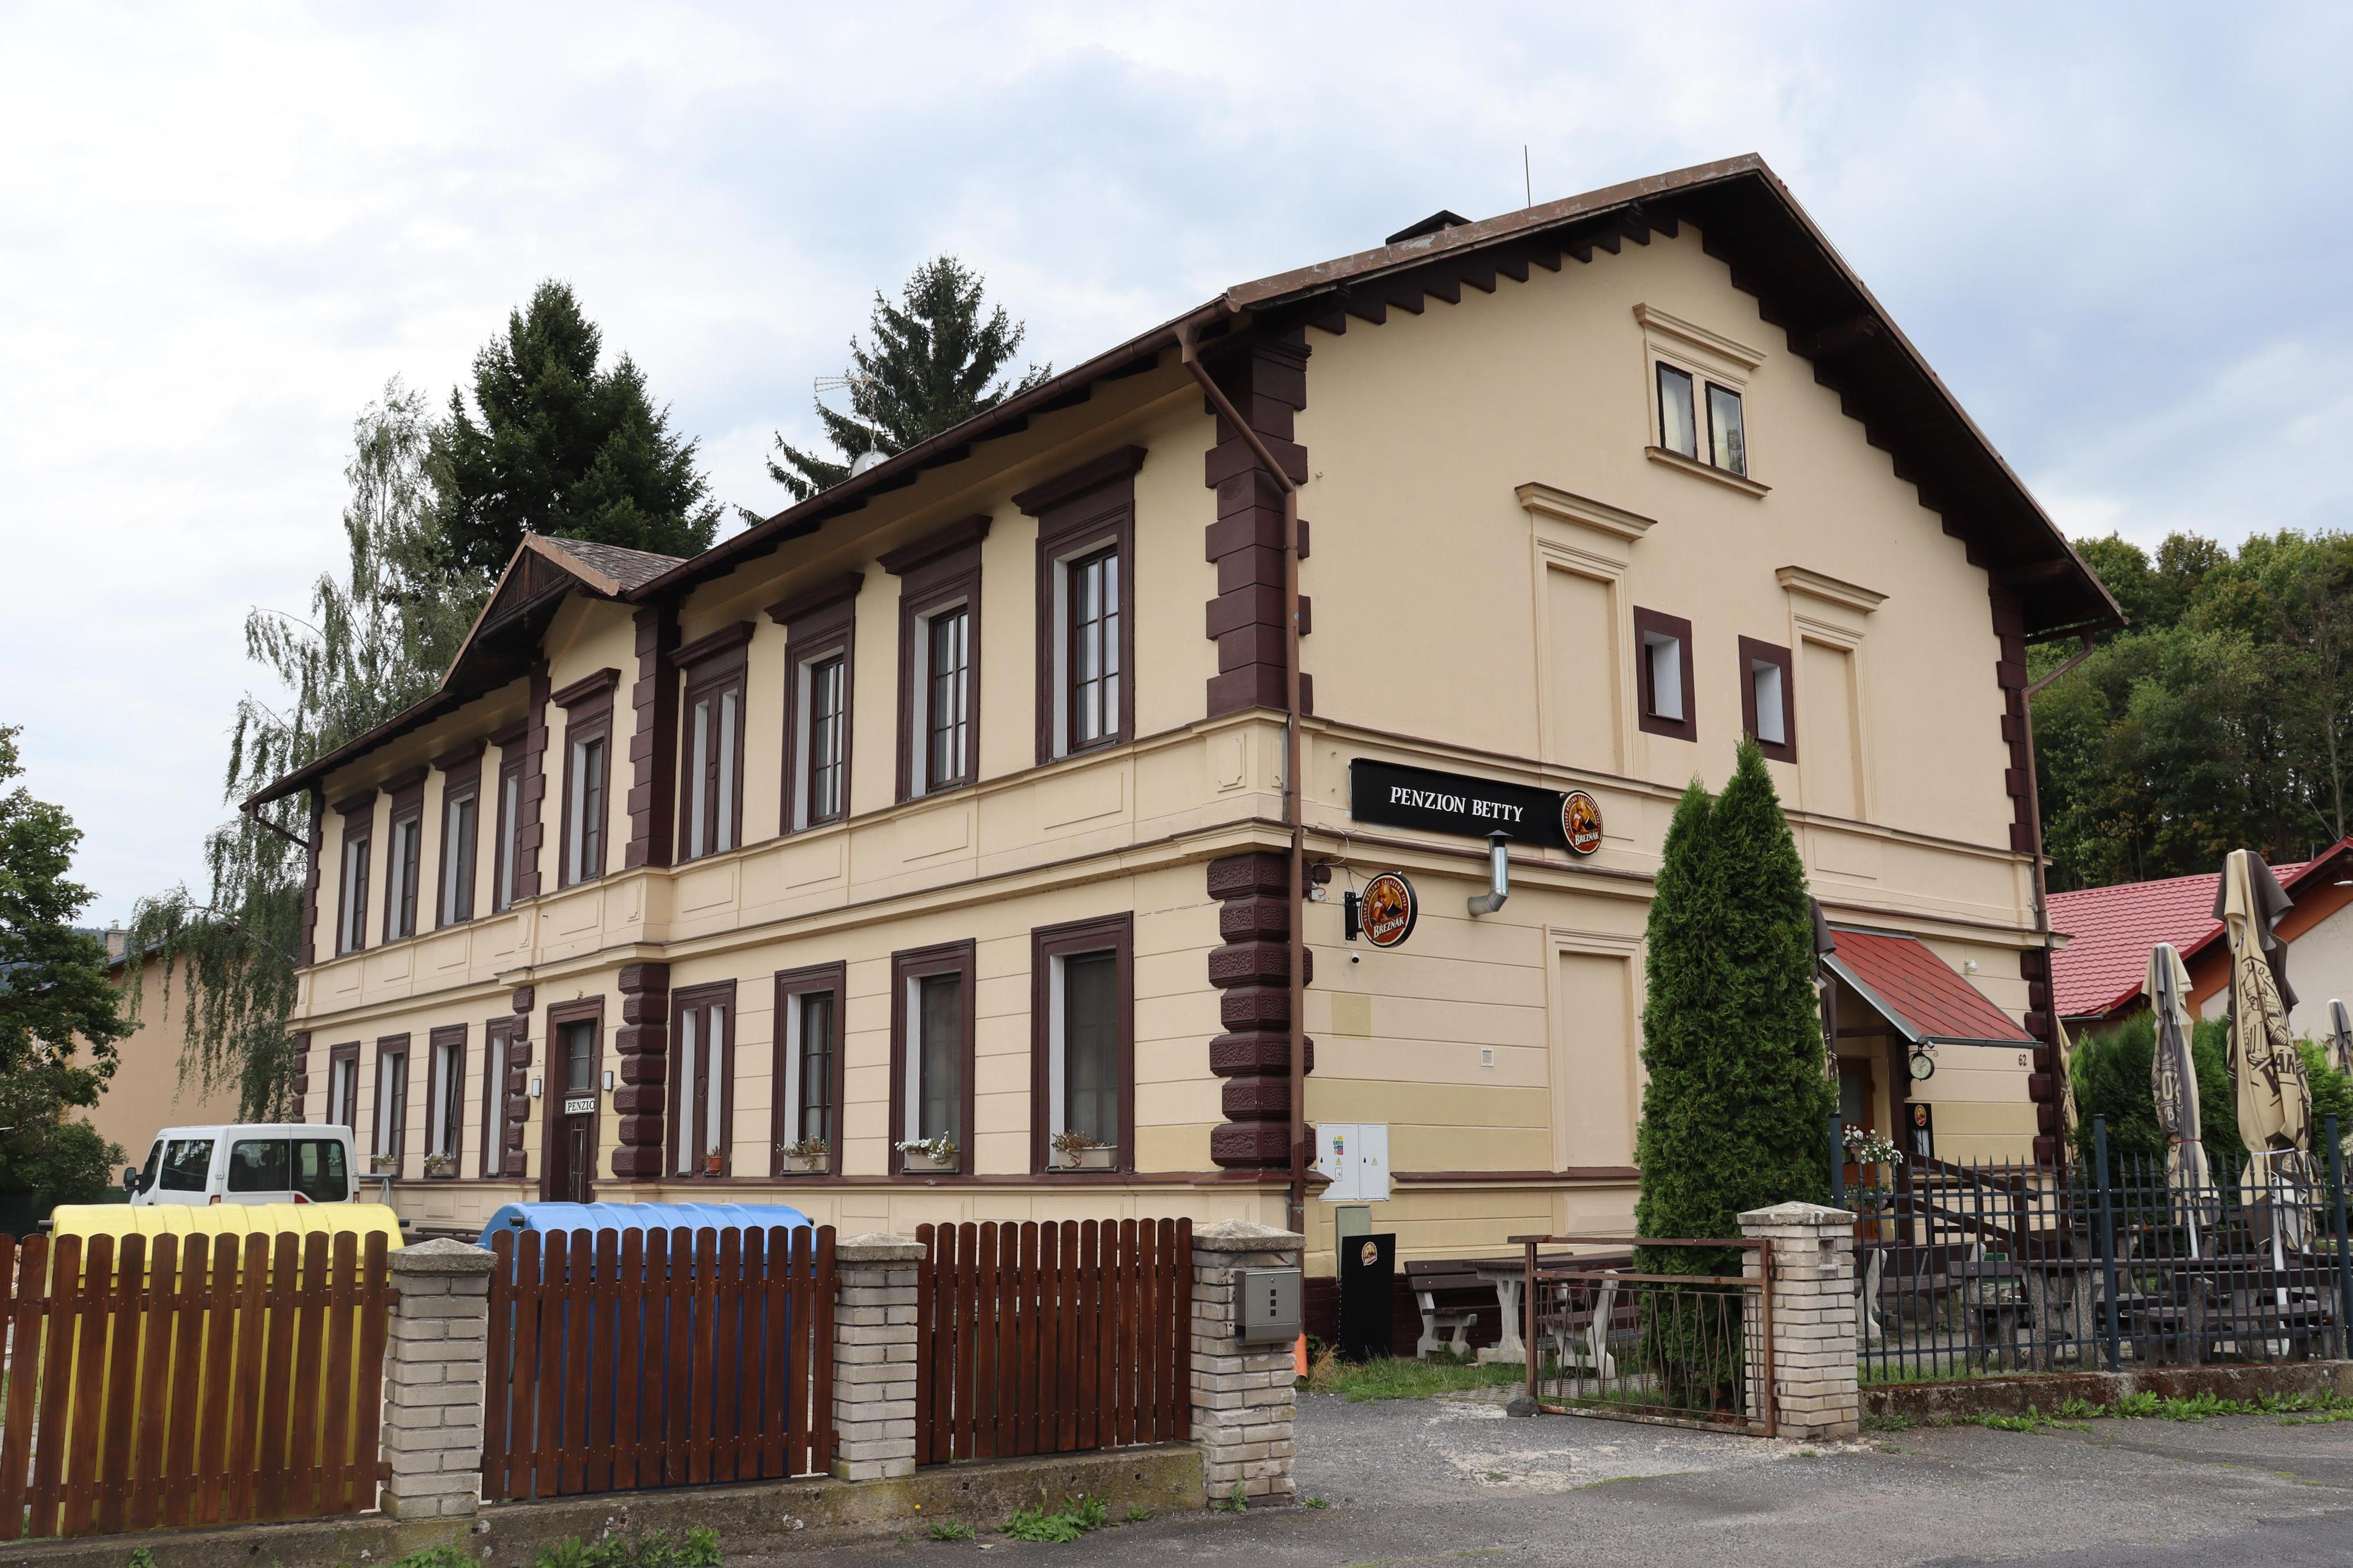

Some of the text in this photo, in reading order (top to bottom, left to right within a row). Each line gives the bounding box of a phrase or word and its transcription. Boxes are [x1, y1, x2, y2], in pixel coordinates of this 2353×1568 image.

[1389, 786, 1524, 822] PENZION BETTY
[1575, 831, 1599, 846] BŘEZŇÁK
[1374, 916, 1405, 939] BŘEZŇÁK
[2018, 1053, 2027, 1066] 62
[568, 1100, 595, 1112] PENZIO
